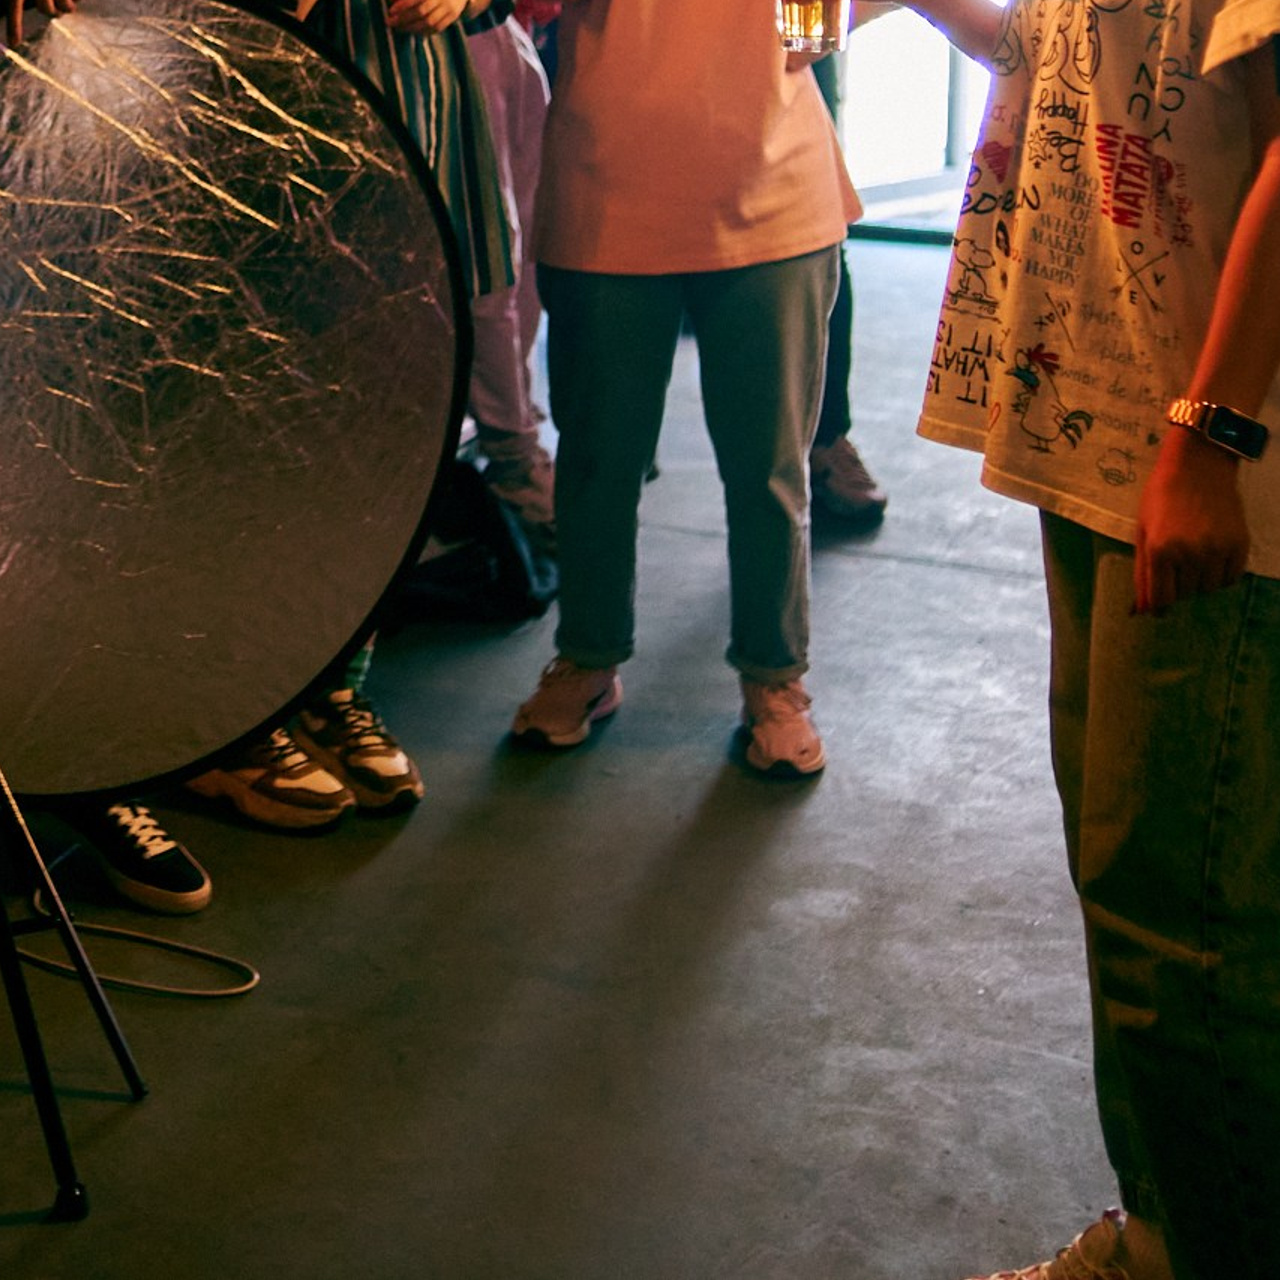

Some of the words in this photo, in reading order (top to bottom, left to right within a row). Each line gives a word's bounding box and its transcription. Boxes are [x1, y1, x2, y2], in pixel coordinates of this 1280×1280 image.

[1034, 88, 1089, 136] Happy
[1046, 132, 1086, 174] Be
[1050, 182, 1097, 207] MORE
[1111, 133, 1152, 229] MATATA
[1040, 213, 1089, 240] WHAT
[1070, 206, 1092, 224] OF
[1031, 226, 1086, 256] MAKES
[1024, 258, 1080, 287] HAPPY
[1049, 249, 1079, 270] YOU
[936, 320, 953, 348] IS
[960, 330, 993, 359] IT
[931, 347, 990, 382] WHAT
[926, 370, 941, 395] IS
[955, 381, 987, 408] IT
[1107, 375, 1128, 399] de
